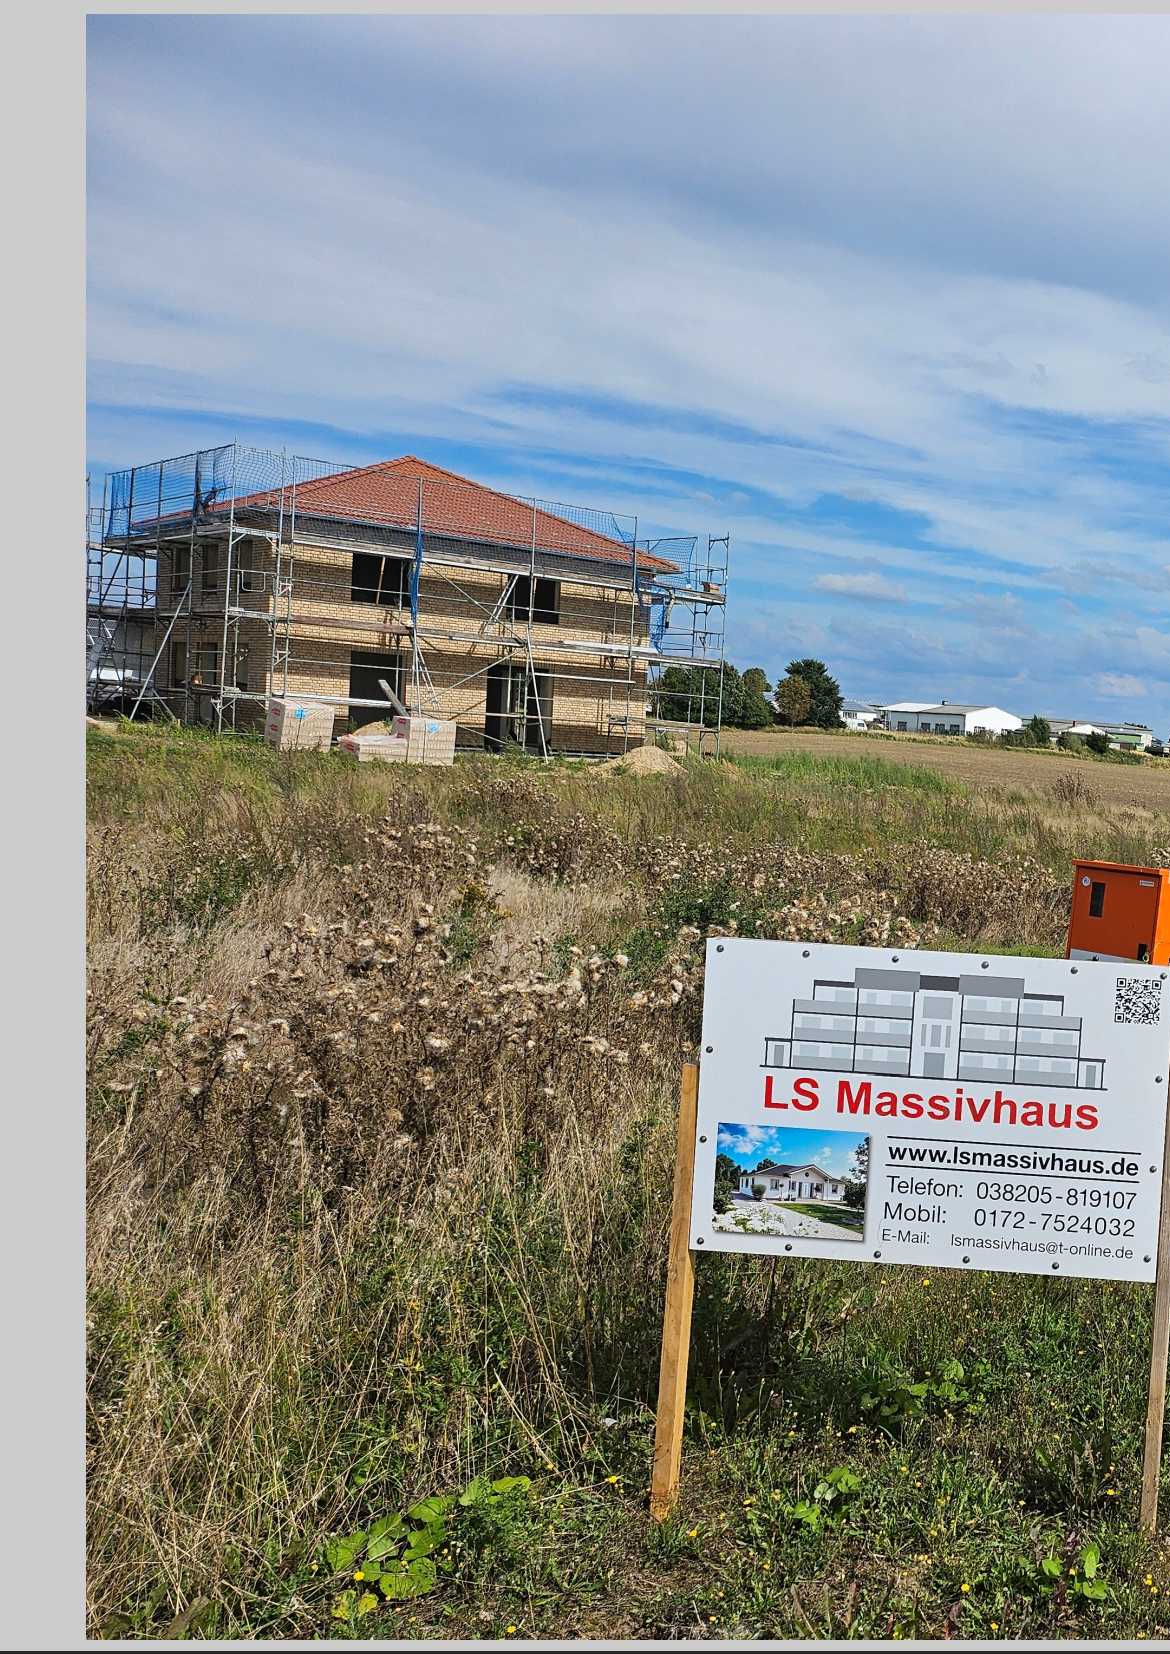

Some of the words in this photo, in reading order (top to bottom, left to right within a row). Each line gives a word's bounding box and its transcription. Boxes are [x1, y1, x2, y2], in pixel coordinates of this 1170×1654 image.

[763, 1075, 819, 1112] LS
[836, 1079, 1100, 1131] Massivhaus
[888, 1145, 1139, 1176] www.lsmassivhaus.de
[885, 1174, 964, 1198] Telefon:
[883, 1201, 947, 1224] Mobil:
[881, 1228, 931, 1245] E-Mail:
[950, 1233, 1134, 1259] lsmassivhaus@t-online.de
